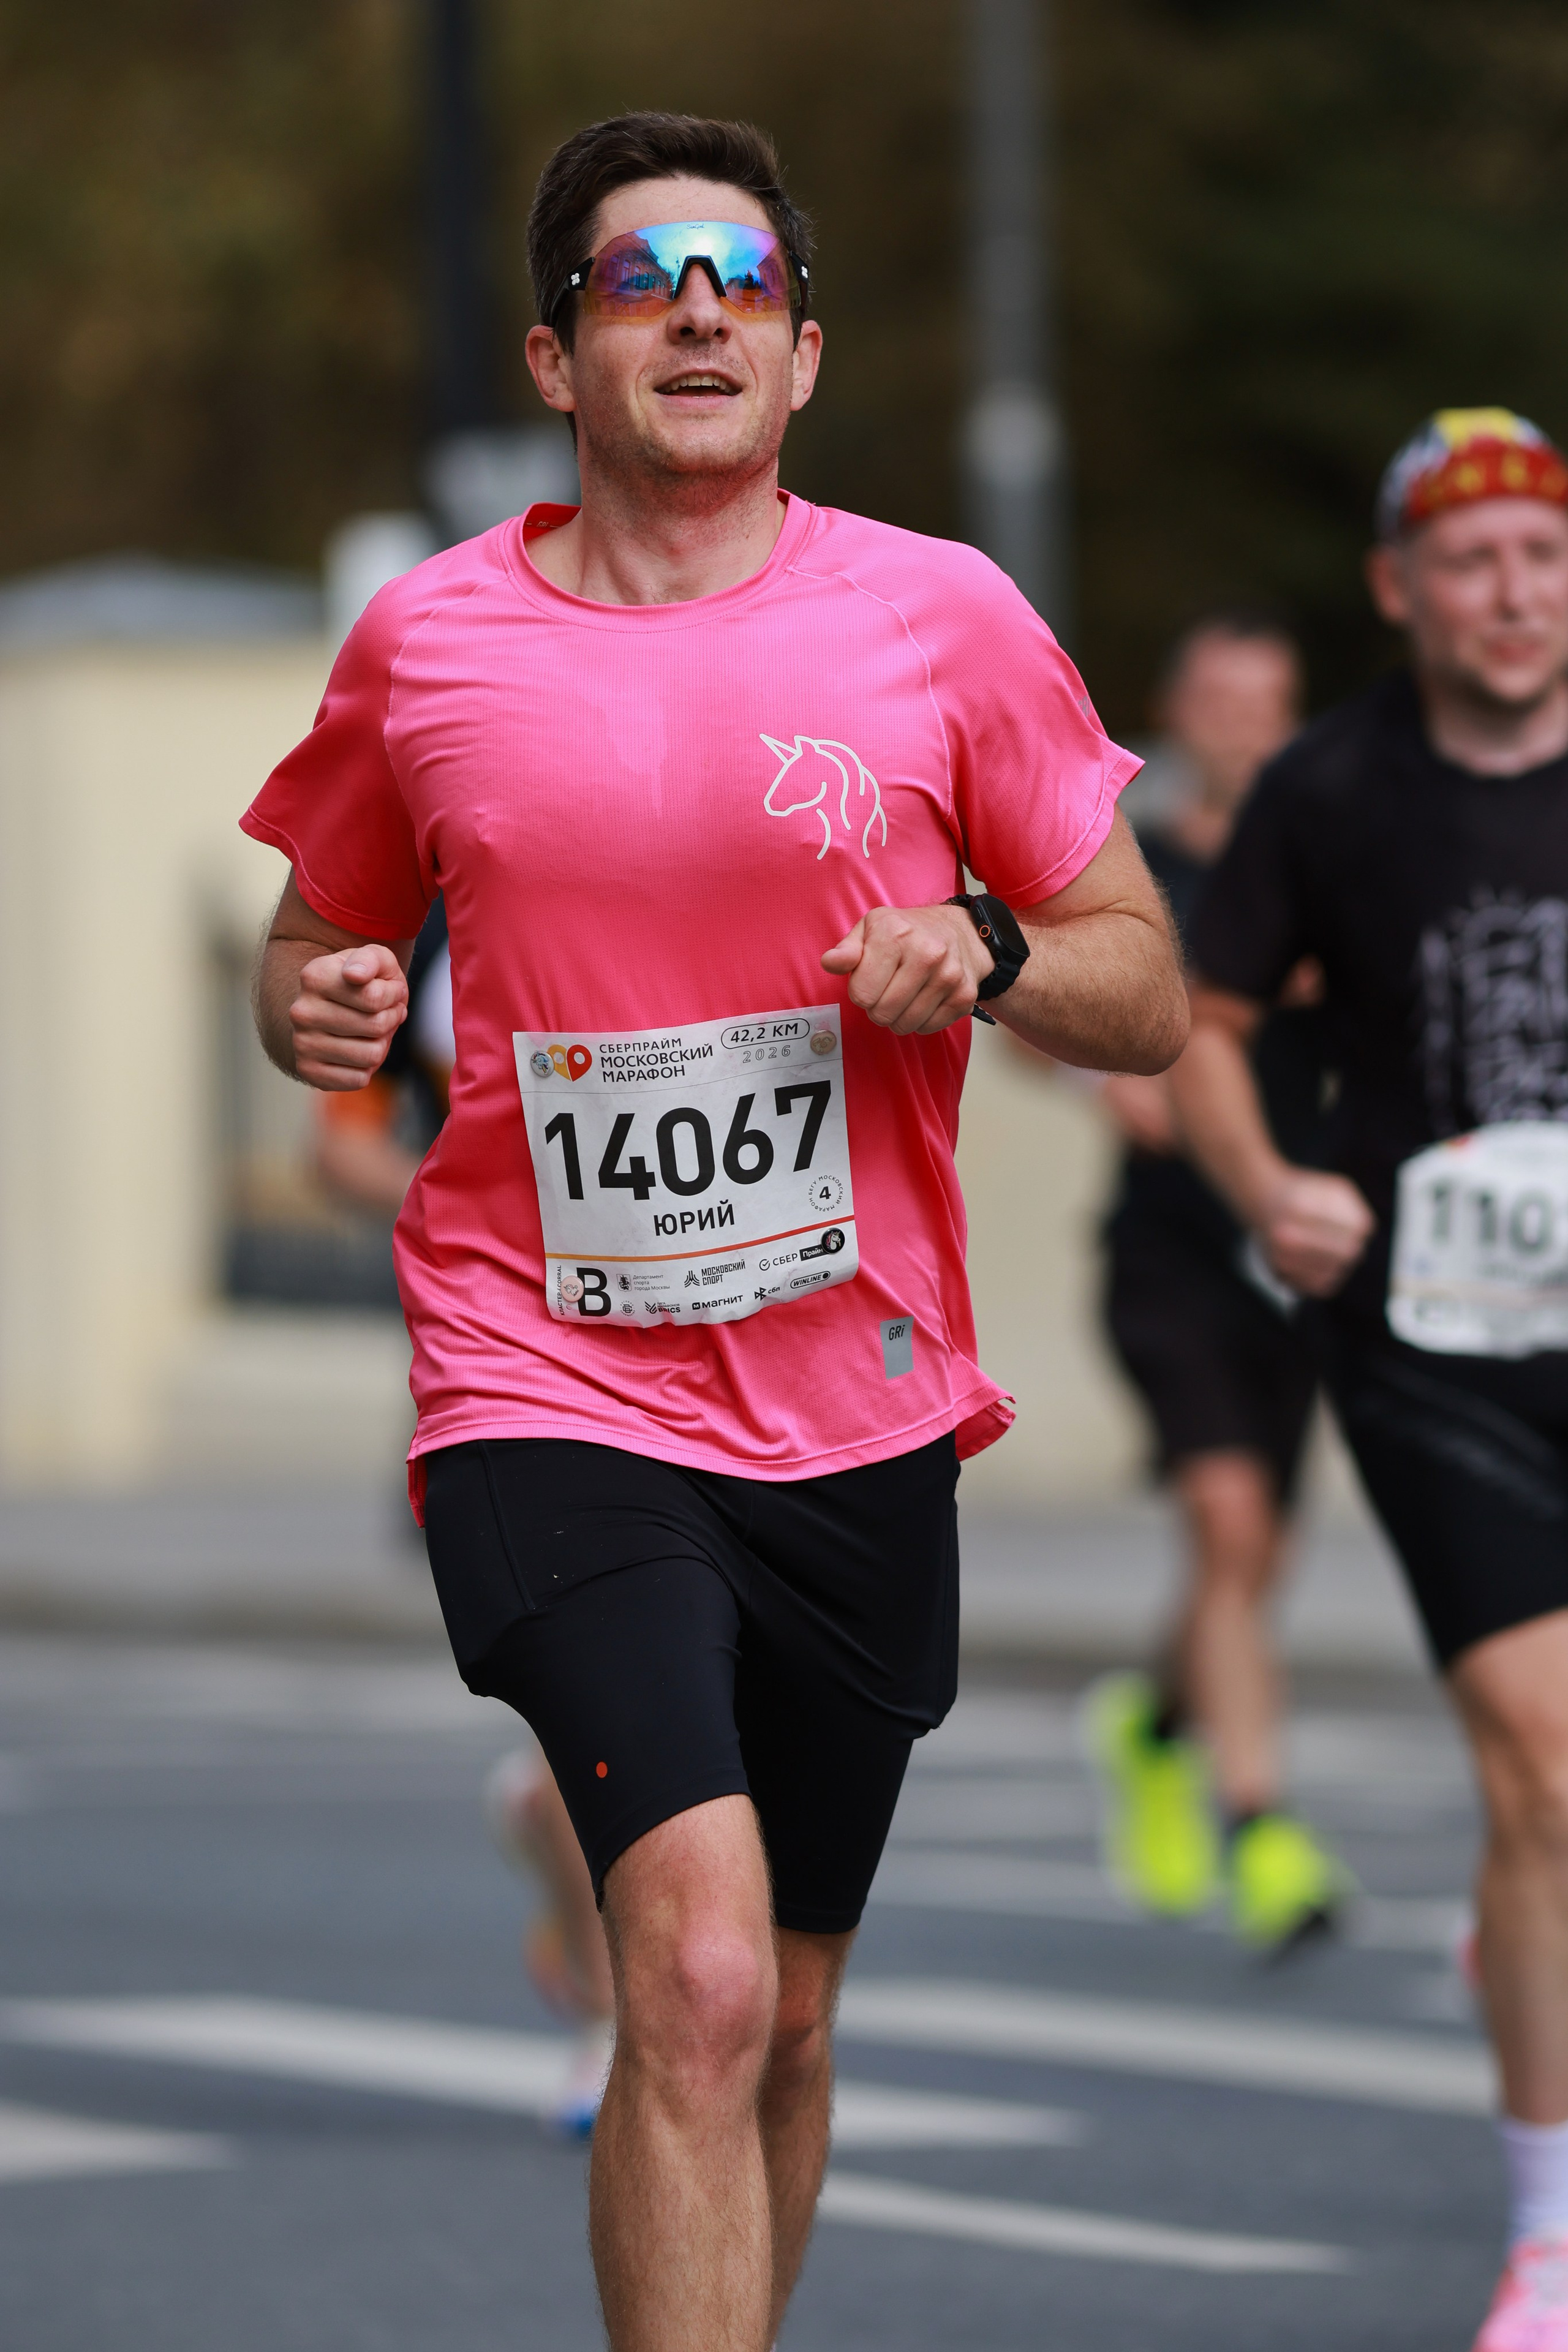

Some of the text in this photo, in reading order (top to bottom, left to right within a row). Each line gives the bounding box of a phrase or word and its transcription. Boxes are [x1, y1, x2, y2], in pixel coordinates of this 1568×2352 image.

[731, 1023, 799, 1042] 42,2 КМ
[599, 1038, 682, 1054] СБЕРПРАЙМ
[743, 1045, 791, 1063] 2026
[600, 1043, 714, 1068] МОСКОВСКИЙ
[603, 1065, 685, 1082] МАРАФОН
[545, 1080, 831, 1200] 14067
[819, 1186, 831, 1200] 4
[654, 1199, 735, 1236] ЮРИЙ
[1424, 1176, 1568, 1259] 110
[772, 1248, 823, 1266] СБЕР Прайм
[701, 1259, 745, 1276] МОСКОВСКИЙ
[703, 1275, 723, 1286] СПОРТ
[793, 1275, 821, 1287] WINLINE
[702, 1295, 743, 1308] магнит
[889, 1324, 905, 1340] GRi
